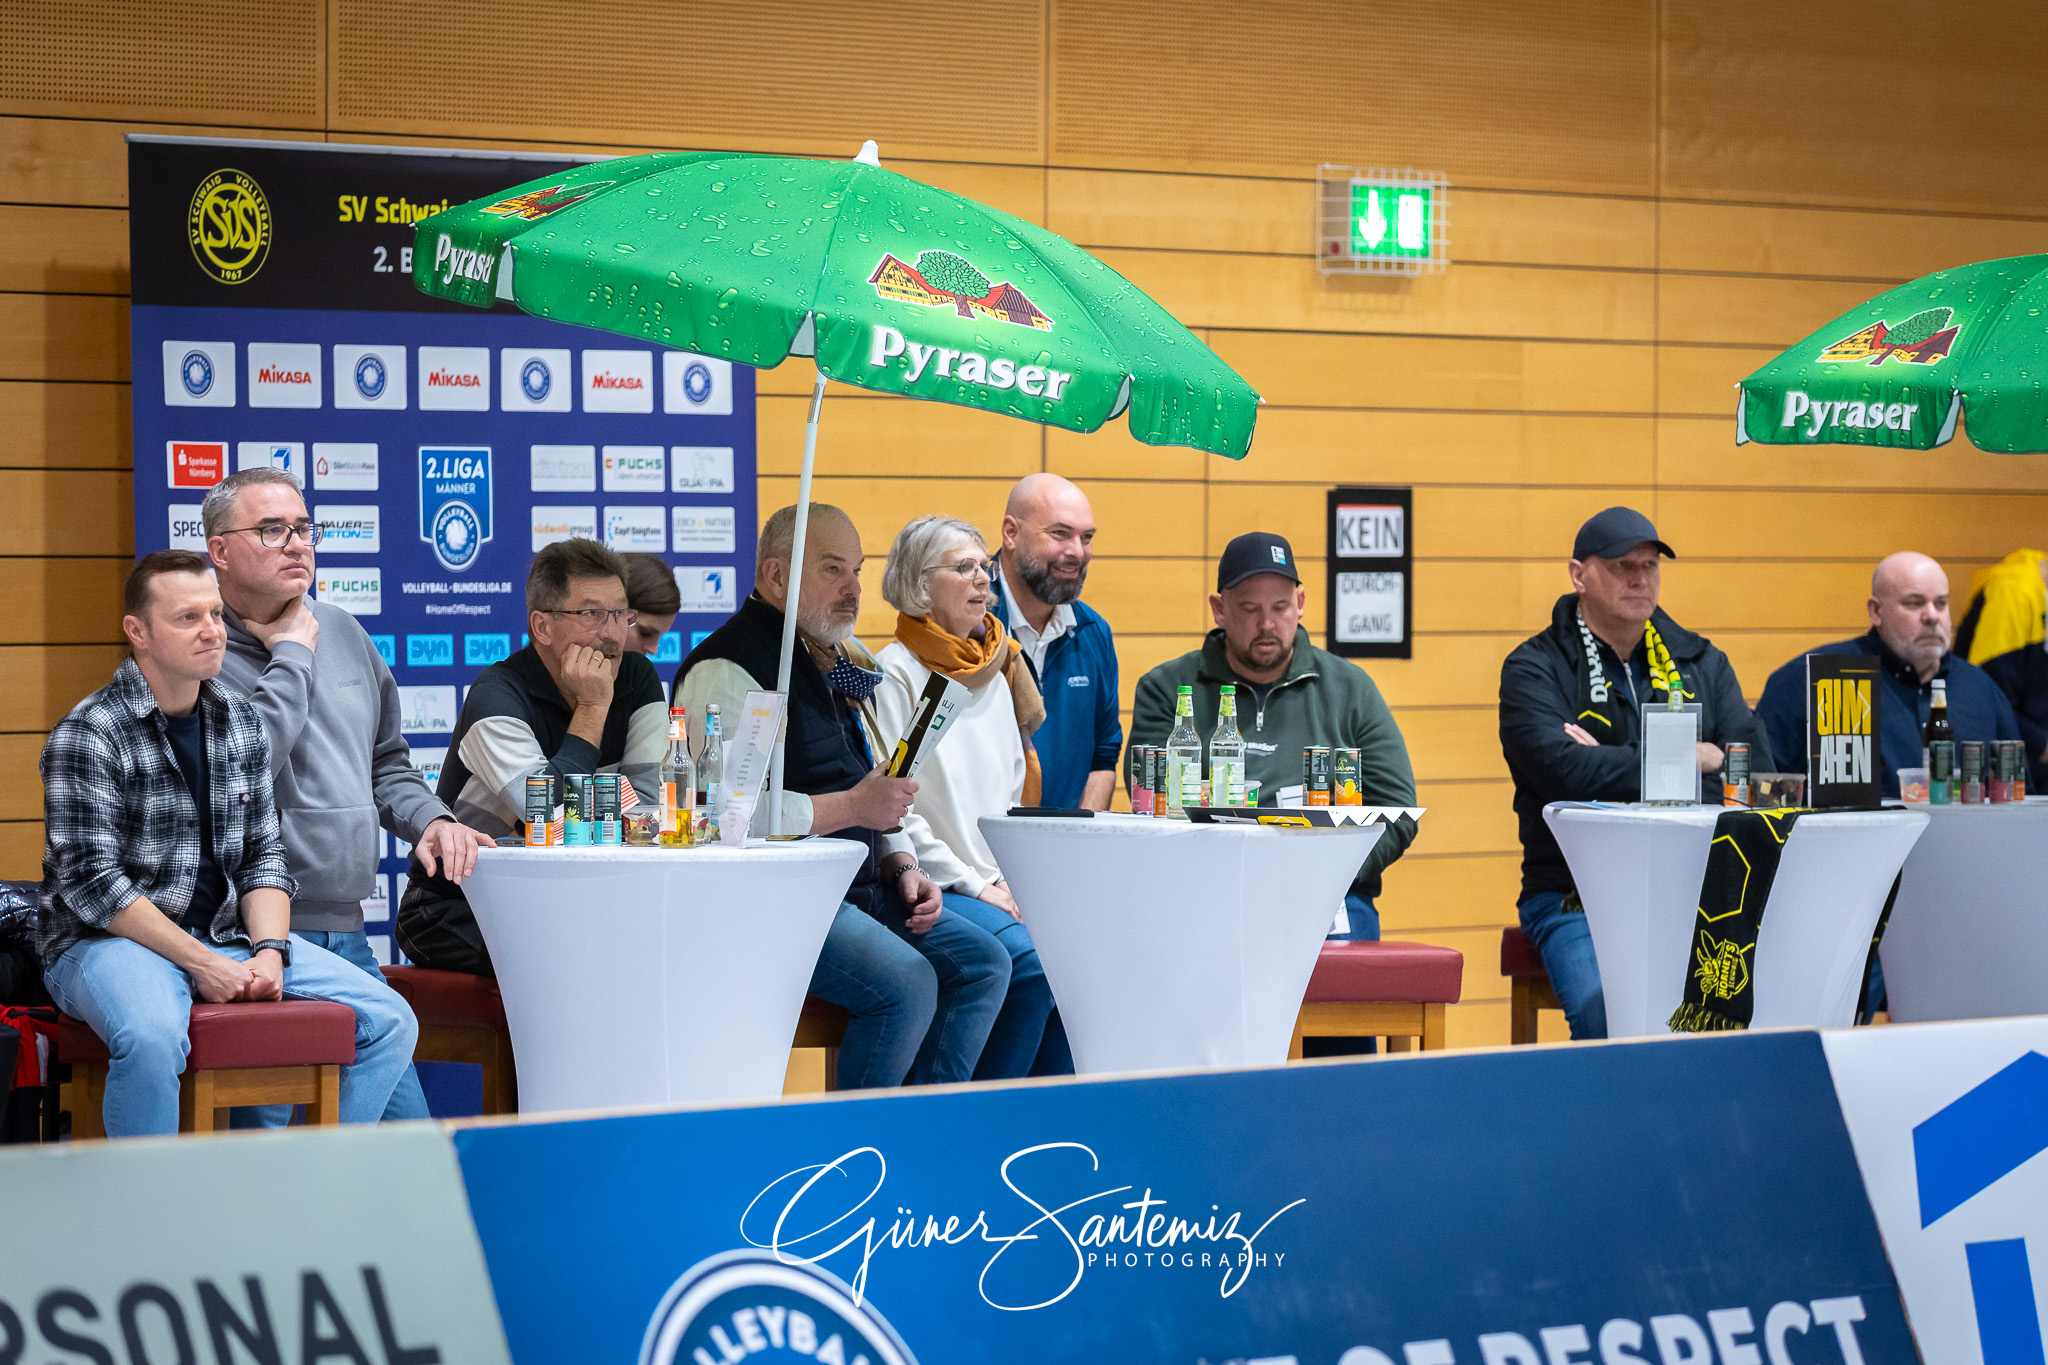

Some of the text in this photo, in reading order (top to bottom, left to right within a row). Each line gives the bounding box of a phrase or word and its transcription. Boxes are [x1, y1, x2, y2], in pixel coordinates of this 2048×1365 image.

[339, 195, 456, 224] SV Schwai
[373, 246, 394, 273] 2.
[221, 269, 242, 280] 1967
[870, 326, 1071, 400] Pyraser
[1782, 391, 1919, 437] Pyraser
[188, 456, 217, 467] Sparkasse
[618, 457, 662, 470] FUCHS
[436, 482, 476, 494] MÄNNER
[438, 507, 475, 531] VOLLEYBALL
[323, 530, 361, 539] ETON
[1339, 518, 1400, 549] KEIN
[332, 580, 379, 592] FUCHS
[1348, 616, 1392, 633] GANG
[1718, 943, 1737, 998] HORNETS
